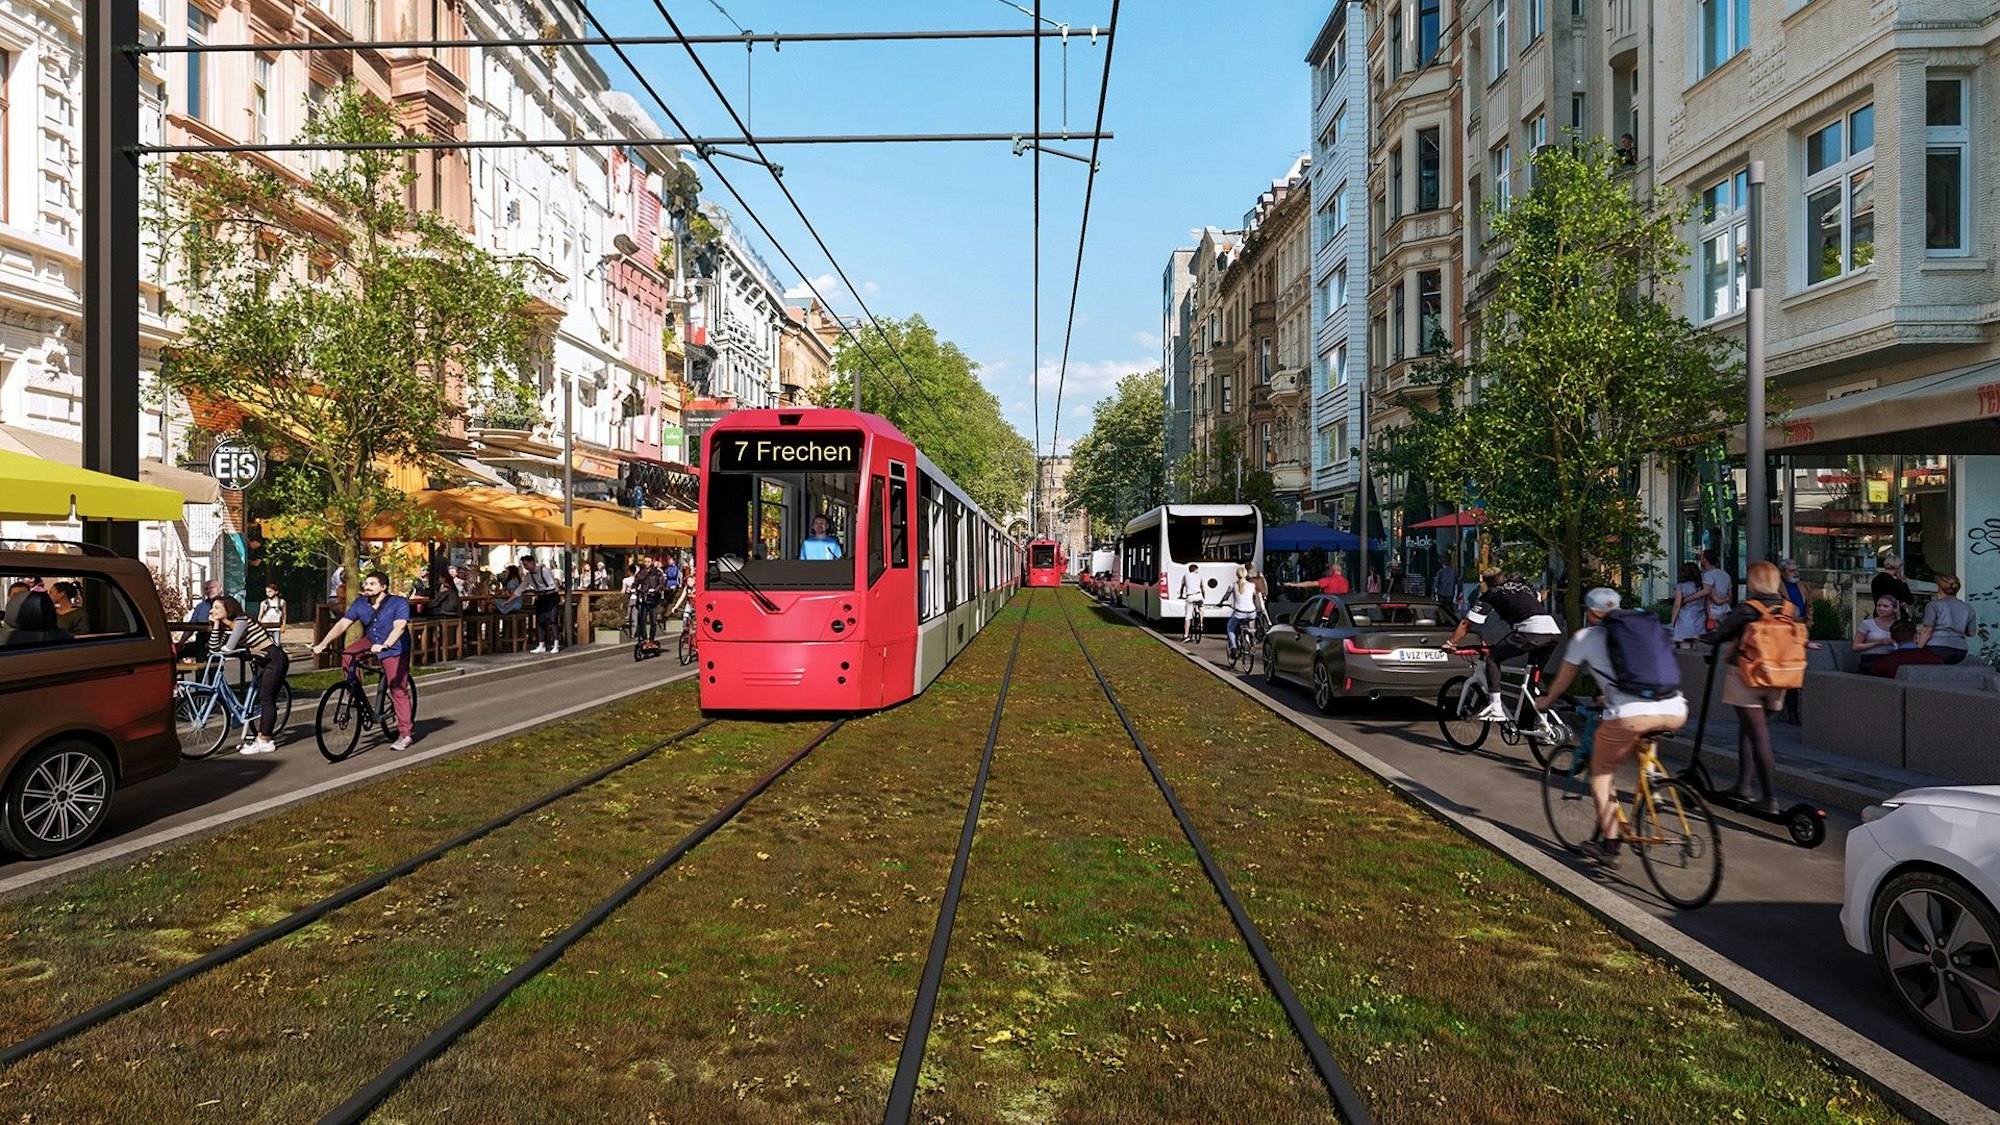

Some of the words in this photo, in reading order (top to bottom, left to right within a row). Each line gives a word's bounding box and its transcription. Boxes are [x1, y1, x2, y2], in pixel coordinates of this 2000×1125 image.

[735, 441, 748, 461] 7
[757, 441, 851, 462] Frechen
[215, 453, 256, 478] EIS
